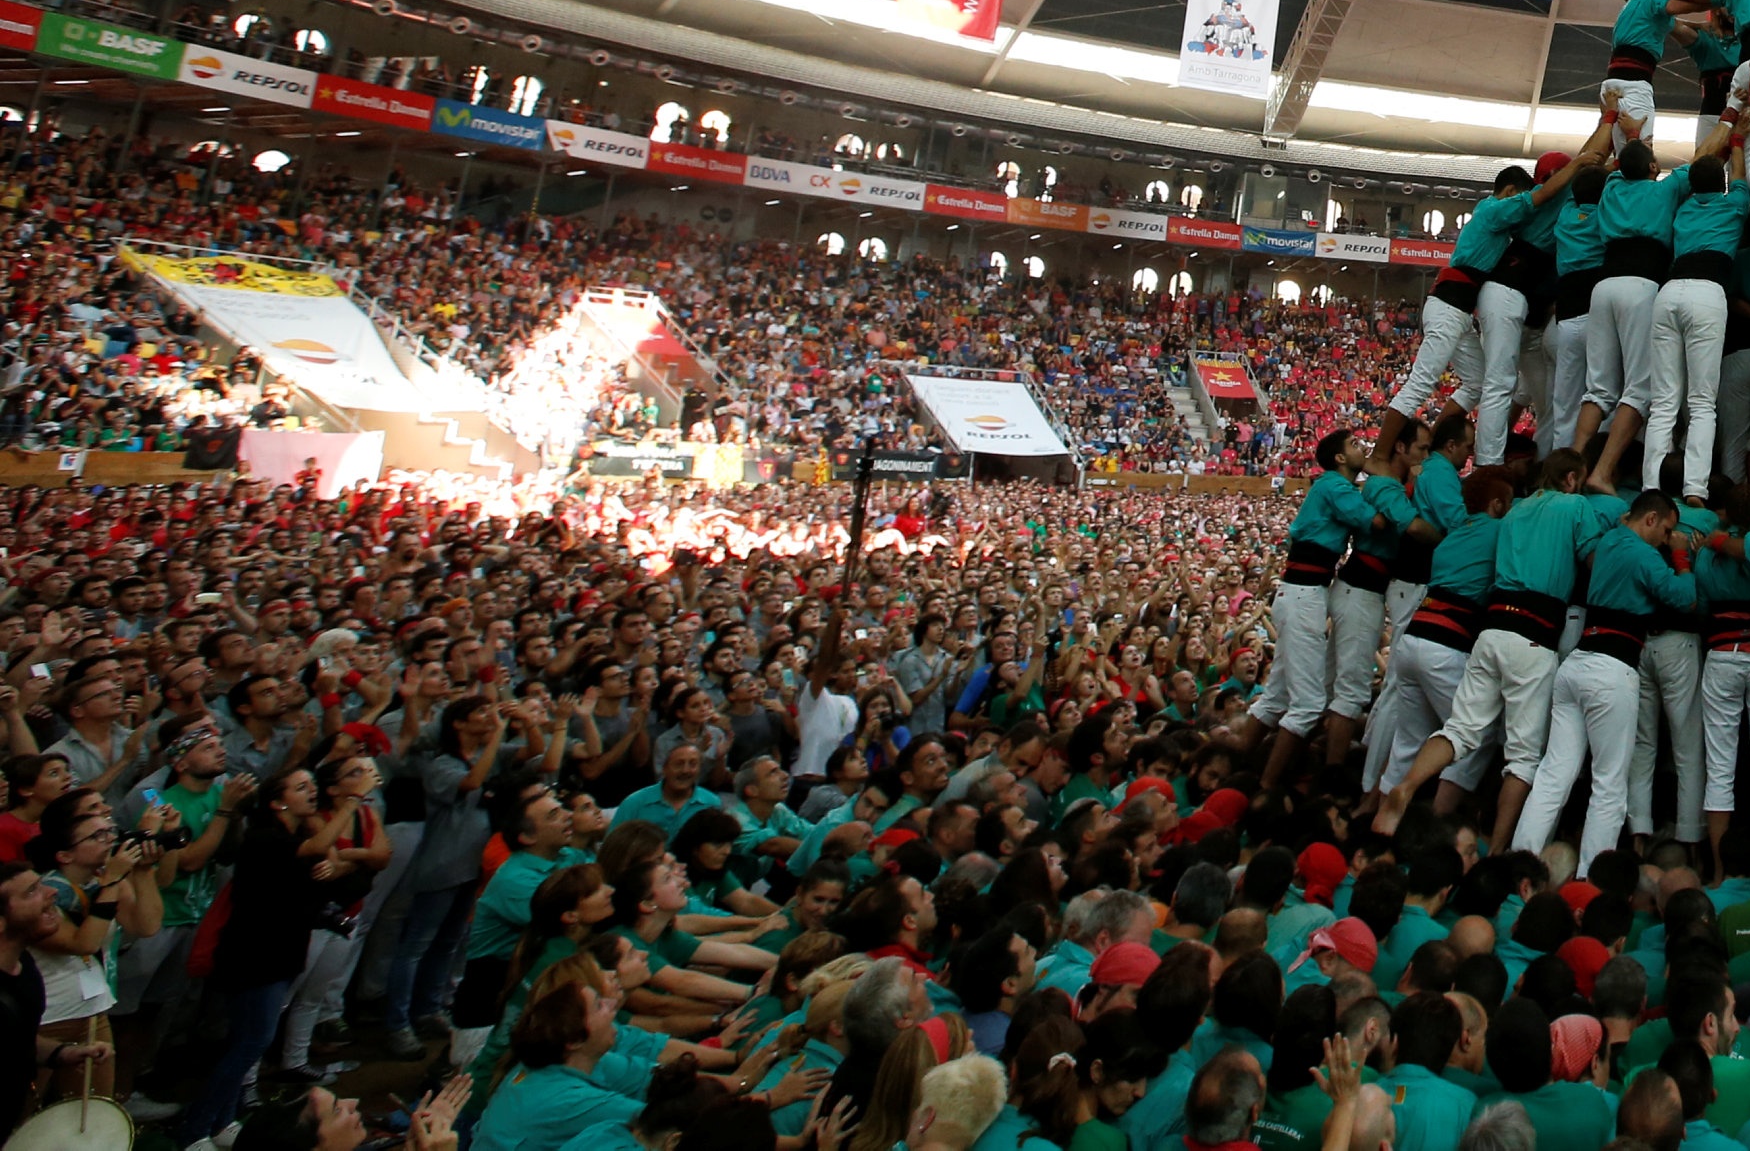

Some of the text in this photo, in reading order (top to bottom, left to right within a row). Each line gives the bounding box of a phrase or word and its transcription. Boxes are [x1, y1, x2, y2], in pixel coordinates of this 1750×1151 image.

[97, 29, 168, 56] BASF
[233, 70, 310, 97] REPSOL
[1213, 68, 1261, 85] Tarragona
[334, 89, 386, 112] Estrella
[470, 118, 542, 140] movistar
[583, 138, 644, 158] REPSOL
[663, 151, 706, 169] Estrella
[750, 165, 921, 202] BBVA CX REPSOL
[936, 194, 973, 210] Estrella
[1040, 203, 1077, 218] BASF
[1117, 220, 1164, 233] REPSOL
[1179, 226, 1240, 241] Estrella Damm
[1266, 237, 1315, 250] movistar
[1344, 244, 1388, 255] REPSOL
[1400, 247, 1452, 259] Estrella Dam
[966, 431, 1033, 440] REPSOL
